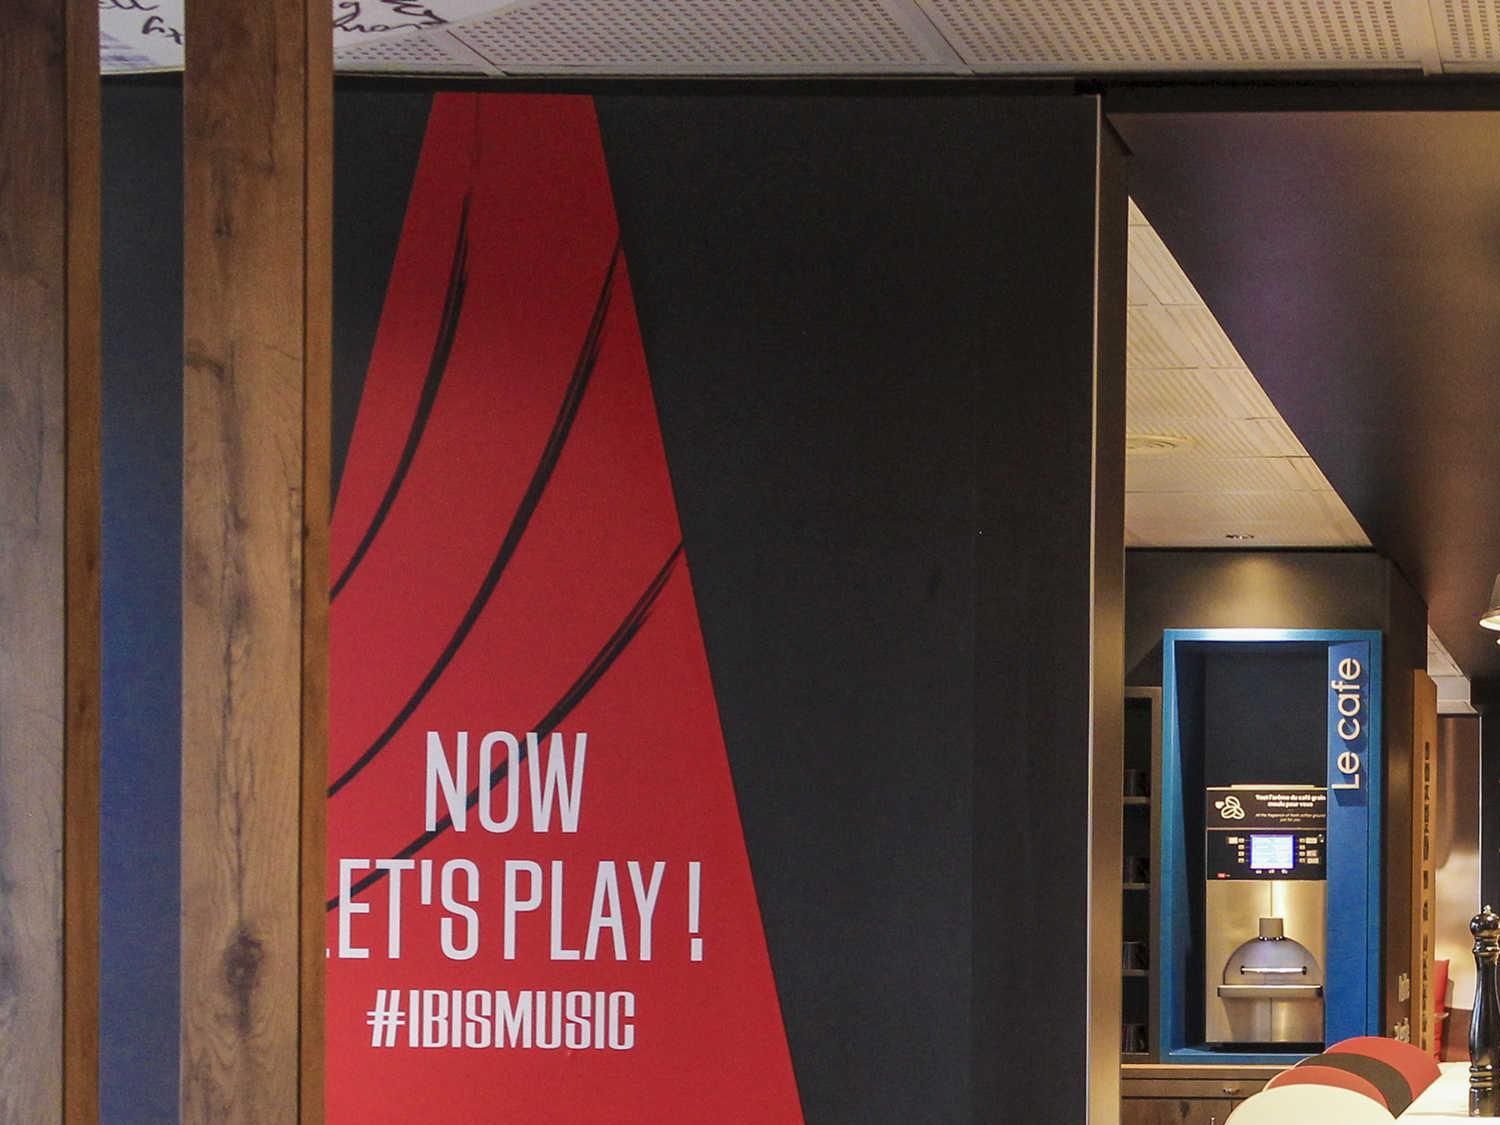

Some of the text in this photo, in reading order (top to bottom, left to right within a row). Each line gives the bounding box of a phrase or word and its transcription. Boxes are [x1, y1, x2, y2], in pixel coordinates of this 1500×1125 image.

[1331, 658, 1361, 790] Le cafe
[425, 731, 588, 833] NOW
[326, 858, 704, 962] ET'S PLAY !
[366, 988, 637, 1051] #IBISMUSIC
